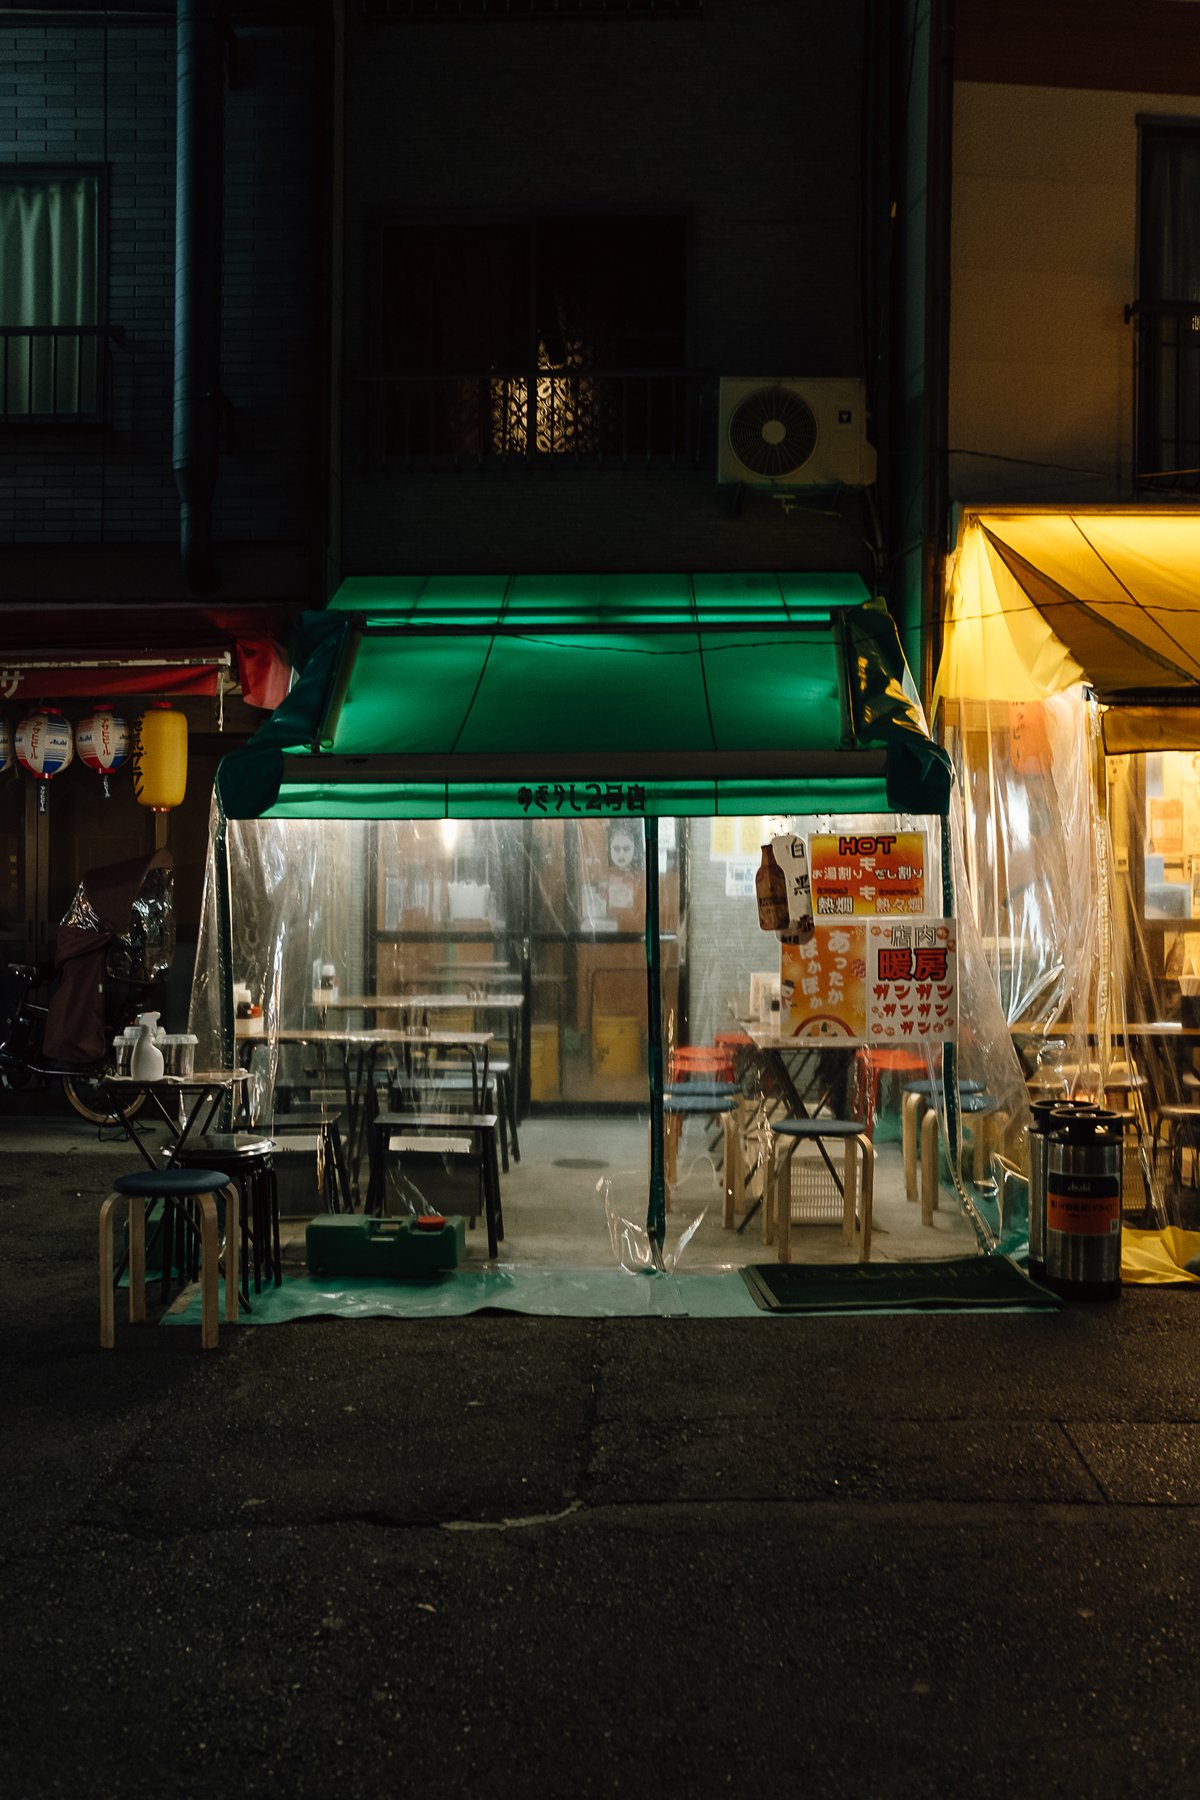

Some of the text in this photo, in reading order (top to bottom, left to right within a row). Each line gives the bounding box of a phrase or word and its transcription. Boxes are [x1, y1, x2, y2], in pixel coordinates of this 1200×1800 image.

[49, 736, 68, 746] Asahi
[790, 838, 805, 859] 白
[839, 836, 897, 856] HOT
[811, 867, 863, 882] お湯割り
[816, 896, 924, 915] 熱燗 熱々燗
[890, 925, 937, 948] 店内
[827, 930, 851, 1006] あったか
[878, 947, 949, 982] 暖房
[872, 983, 954, 1001] ガンガン
[882, 1002, 949, 1018] ガンガン
[900, 1020, 931, 1036] ガン
[1067, 1181, 1091, 1193] Asahi
